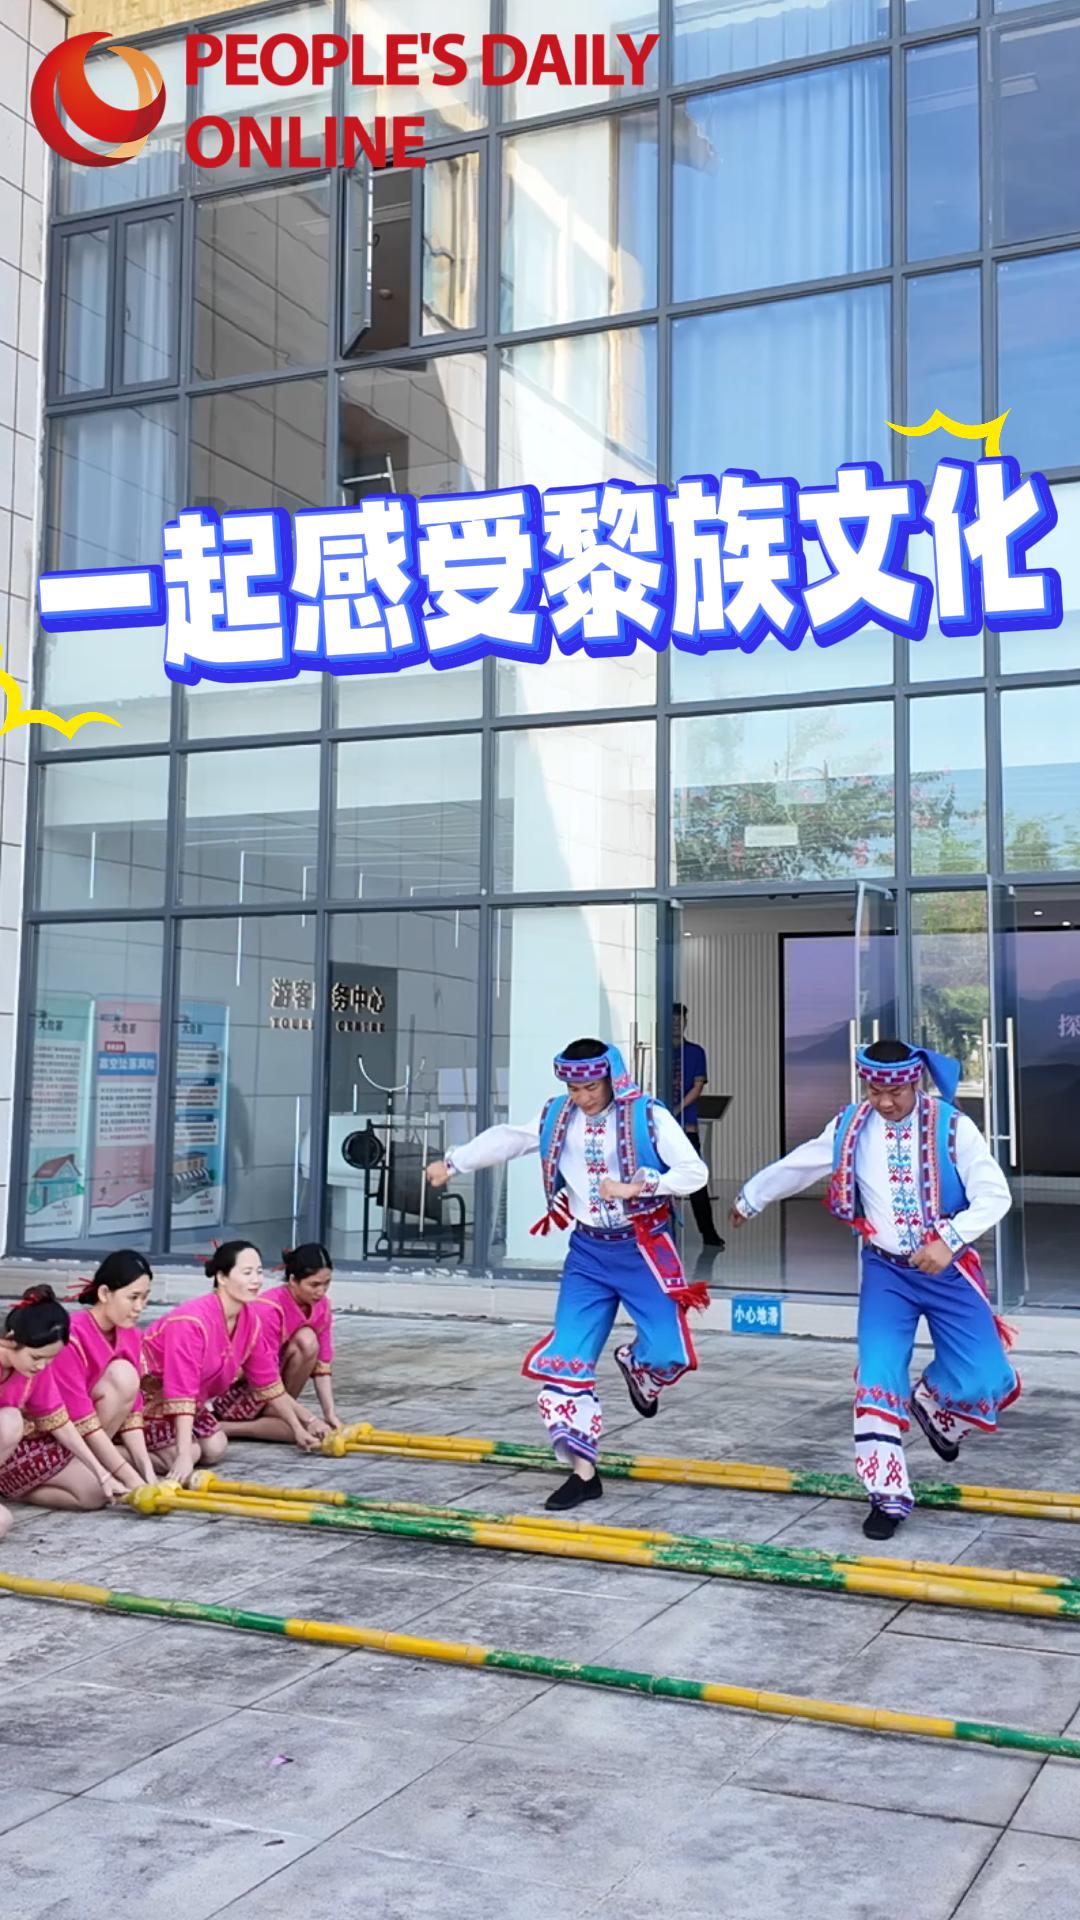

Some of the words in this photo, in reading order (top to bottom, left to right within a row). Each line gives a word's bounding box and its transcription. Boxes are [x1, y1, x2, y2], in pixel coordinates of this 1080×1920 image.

[270, 976, 385, 1014] 游客务中心
[734, 1304, 779, 1327] 小心地滑
